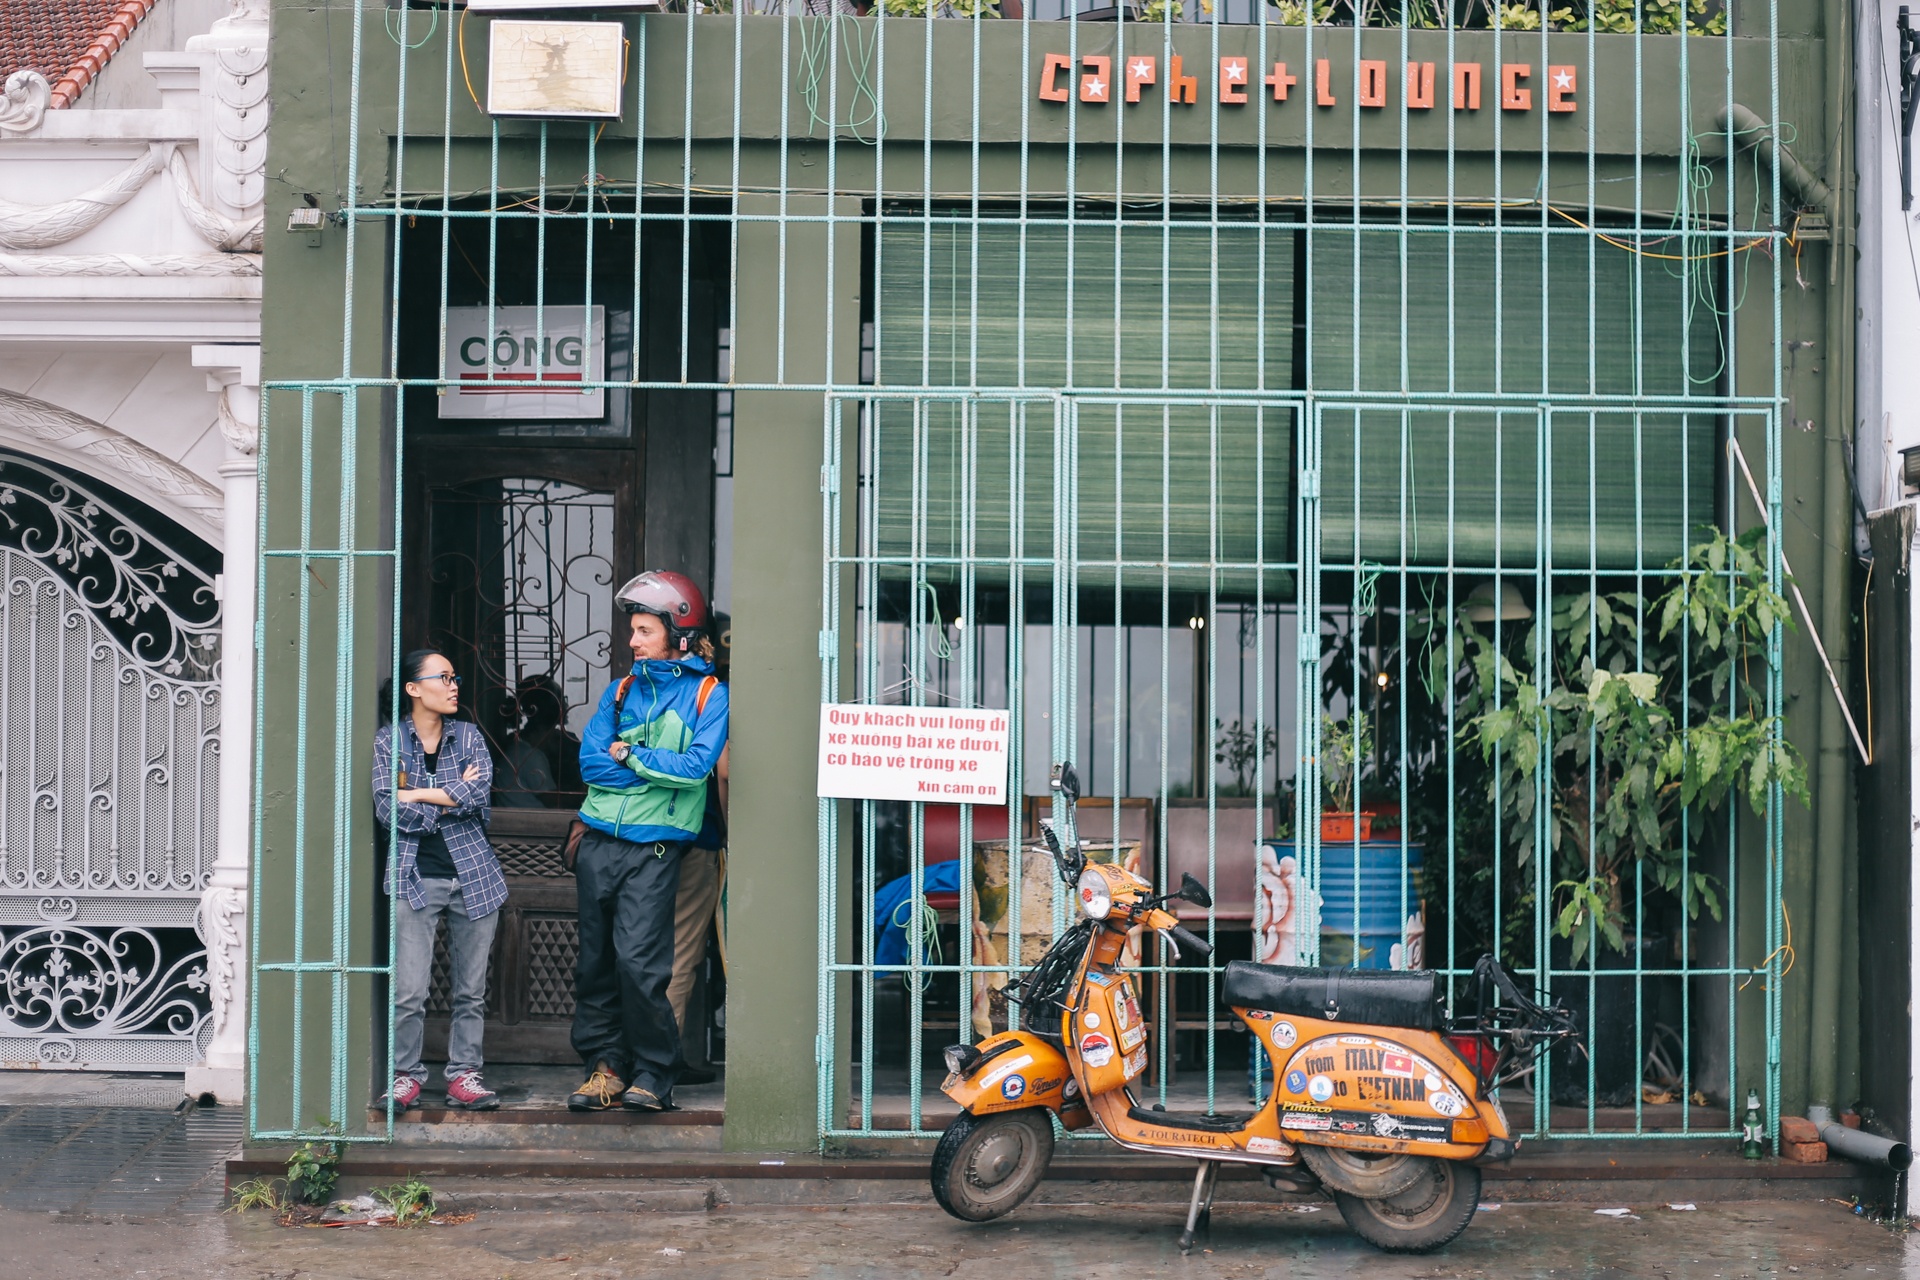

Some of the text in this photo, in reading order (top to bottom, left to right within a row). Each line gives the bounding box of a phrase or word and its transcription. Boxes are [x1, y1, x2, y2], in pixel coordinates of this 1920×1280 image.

[919, 714, 944, 729] vui
[828, 732, 847, 745] xe
[936, 737, 956, 750] xe
[958, 759, 978, 772] xe
[917, 780, 940, 793] Xin
[1305, 1055, 1335, 1076] from
[1333, 1079, 1348, 1098] to
[1281, 1101, 1333, 1114] Pinasco
[1434, 1101, 1452, 1115] GR
[1150, 1130, 1216, 1145] TOURATECH
